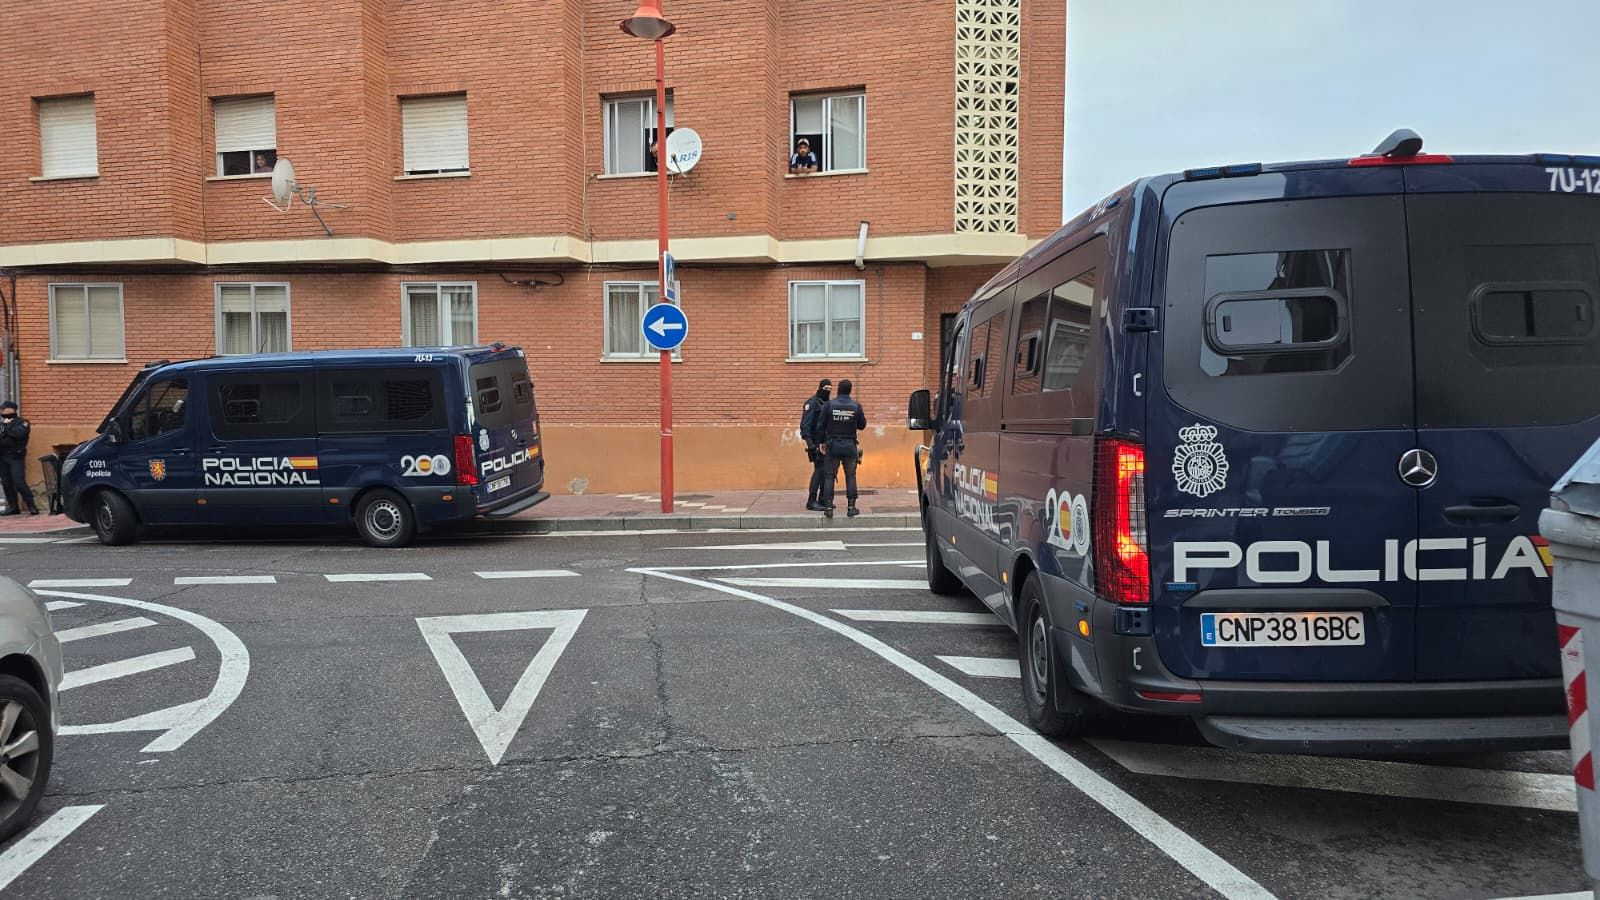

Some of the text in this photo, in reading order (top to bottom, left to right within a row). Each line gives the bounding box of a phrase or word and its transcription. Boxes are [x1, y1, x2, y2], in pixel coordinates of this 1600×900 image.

[204, 471, 321, 485] NACIONAL
[1163, 507, 1269, 518] SPRINTER
[1206, 616, 1361, 642] E CNP3816BC
